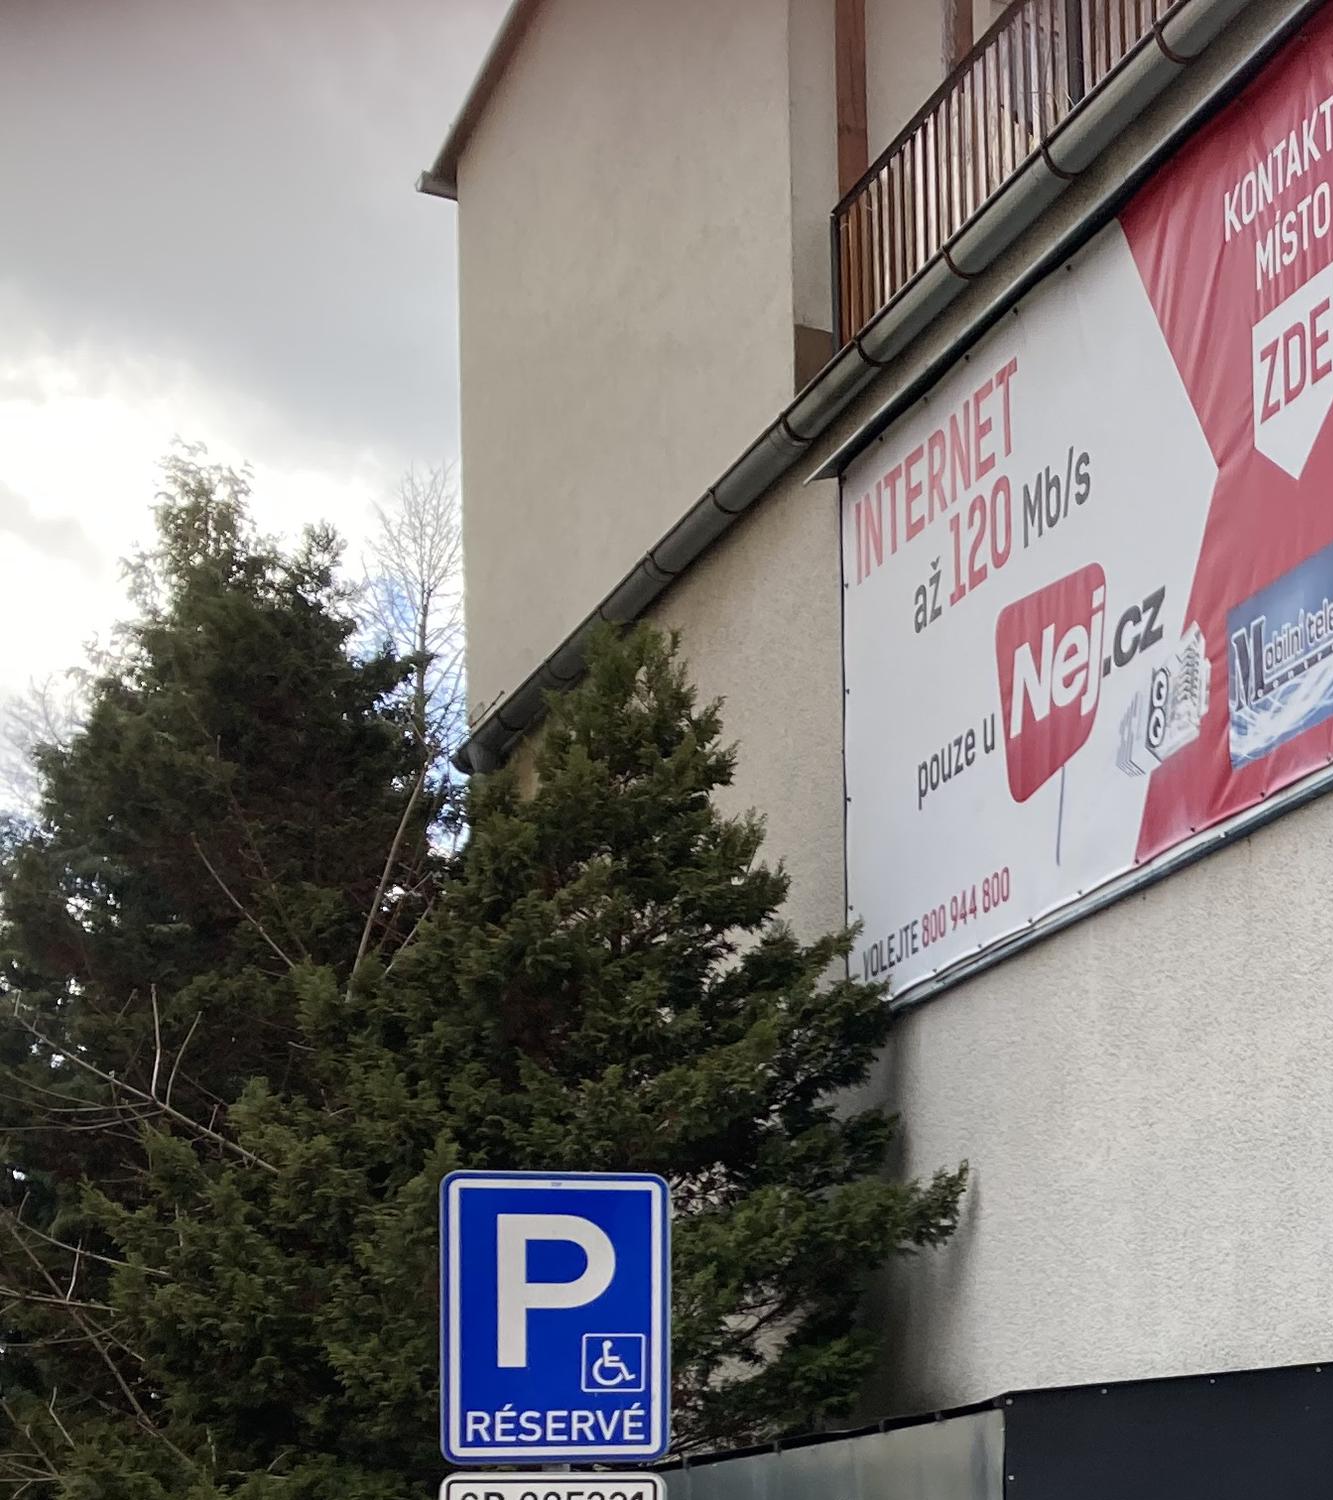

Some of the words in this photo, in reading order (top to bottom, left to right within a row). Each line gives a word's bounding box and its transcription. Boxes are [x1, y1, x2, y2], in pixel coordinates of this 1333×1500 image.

[1255, 183, 1331, 291] MÍSTO
[1259, 297, 1333, 426] ZDE
[854, 356, 1019, 586] INTERNET
[913, 555, 943, 634] až
[949, 474, 1013, 608] 120
[1022, 445, 1092, 550] Mb/s
[917, 740, 976, 810] pouze
[982, 714, 996, 756] u
[862, 919, 919, 982] VOLEJTE
[921, 903, 947, 949] 800
[950, 884, 978, 932] 944
[982, 866, 1010, 914] 800
[496, 1213, 617, 1369] P
[465, 1402, 646, 1443] RÉSERVÉ
